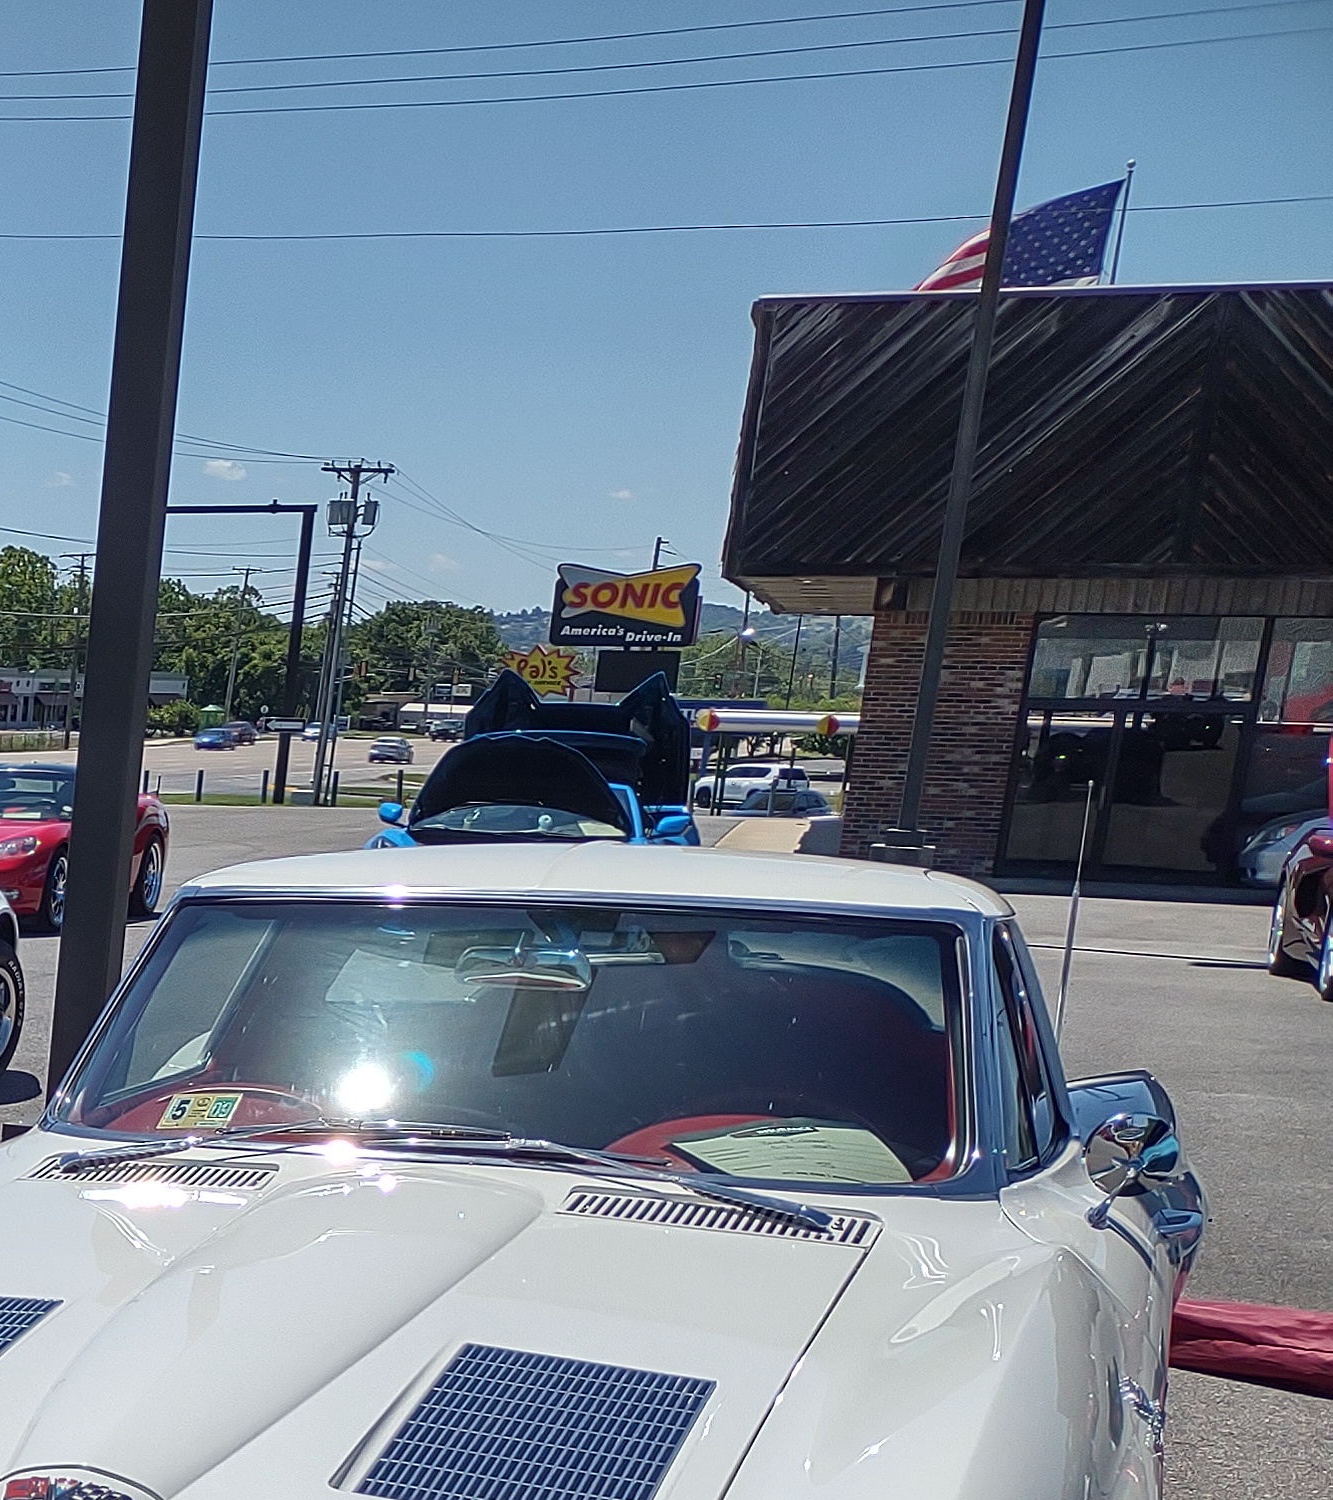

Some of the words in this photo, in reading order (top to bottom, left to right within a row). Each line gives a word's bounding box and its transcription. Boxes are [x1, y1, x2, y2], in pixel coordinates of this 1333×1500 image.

[567, 582, 686, 609] SONIC
[560, 624, 625, 637] America's
[517, 658, 559, 679] Pal's
[171, 1099, 192, 1120] 5
